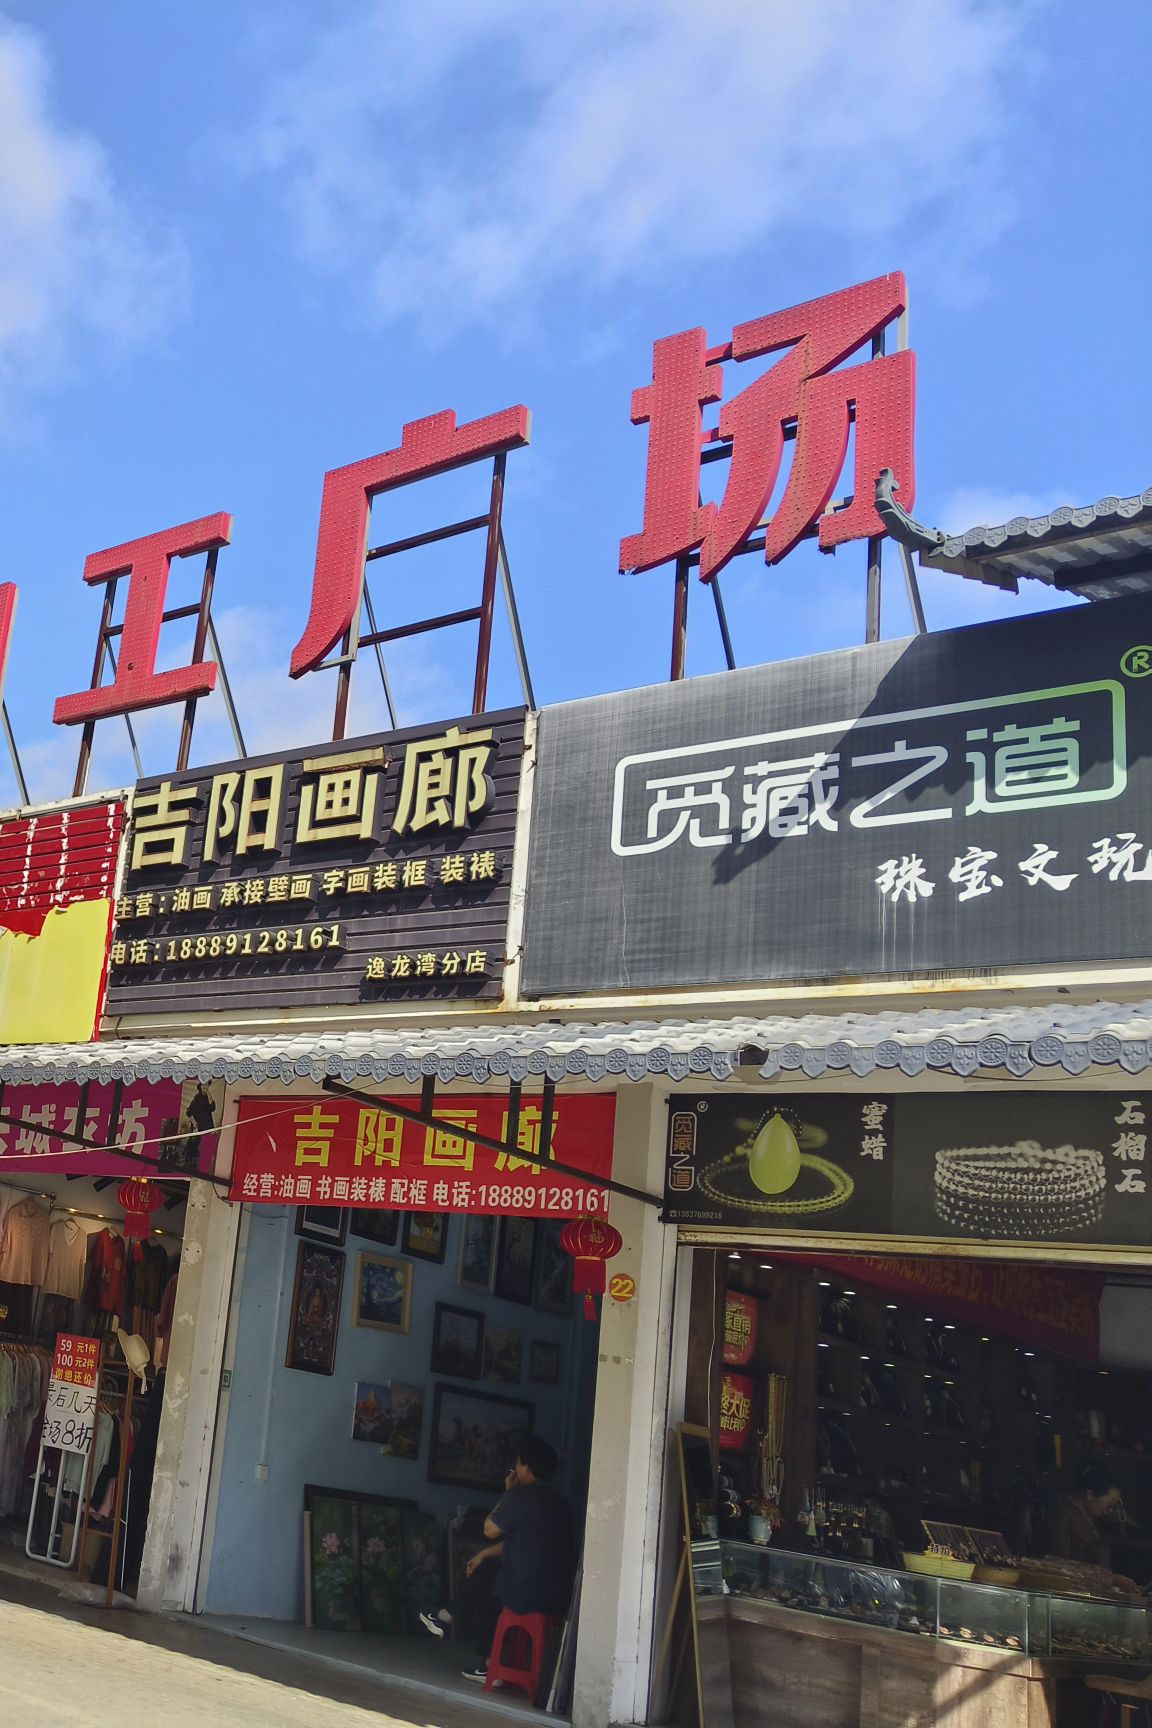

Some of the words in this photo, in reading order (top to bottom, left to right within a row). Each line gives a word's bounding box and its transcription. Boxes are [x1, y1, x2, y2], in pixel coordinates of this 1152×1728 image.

[131, 726, 496, 871] 吉阳画廊
[644, 716, 1081, 849] 觅藏之道
[219, 874, 313, 908] 承接壁画
[322, 861, 426, 897] 字画装框
[440, 851, 496, 883] 装裱
[874, 831, 1152, 903] 珠宝文玩
[110, 925, 341, 966] 电话:18889128161
[366, 950, 487, 981] 逸龙湾分店
[293, 1105, 560, 1177] 吉阳画廊
[674, 1115, 696, 1189] 觅藏之道
[860, 1101, 888, 1161] 蜜蜡
[1112, 1100, 1150, 1194] 石榴石
[315, 1174, 388, 1204] 书画装裱
[390, 1178, 428, 1207] 配框
[432, 1181, 611, 1213] 电话:18889128161
[610, 1278, 633, 1299] 22
[56, 1353, 74, 1367] 100
[75, 1356, 95, 1370] 元2件
[60, 1339, 72, 1352] 59
[76, 1342, 97, 1355] 元1件
[55, 1367, 93, 1385] 谢绝还价
